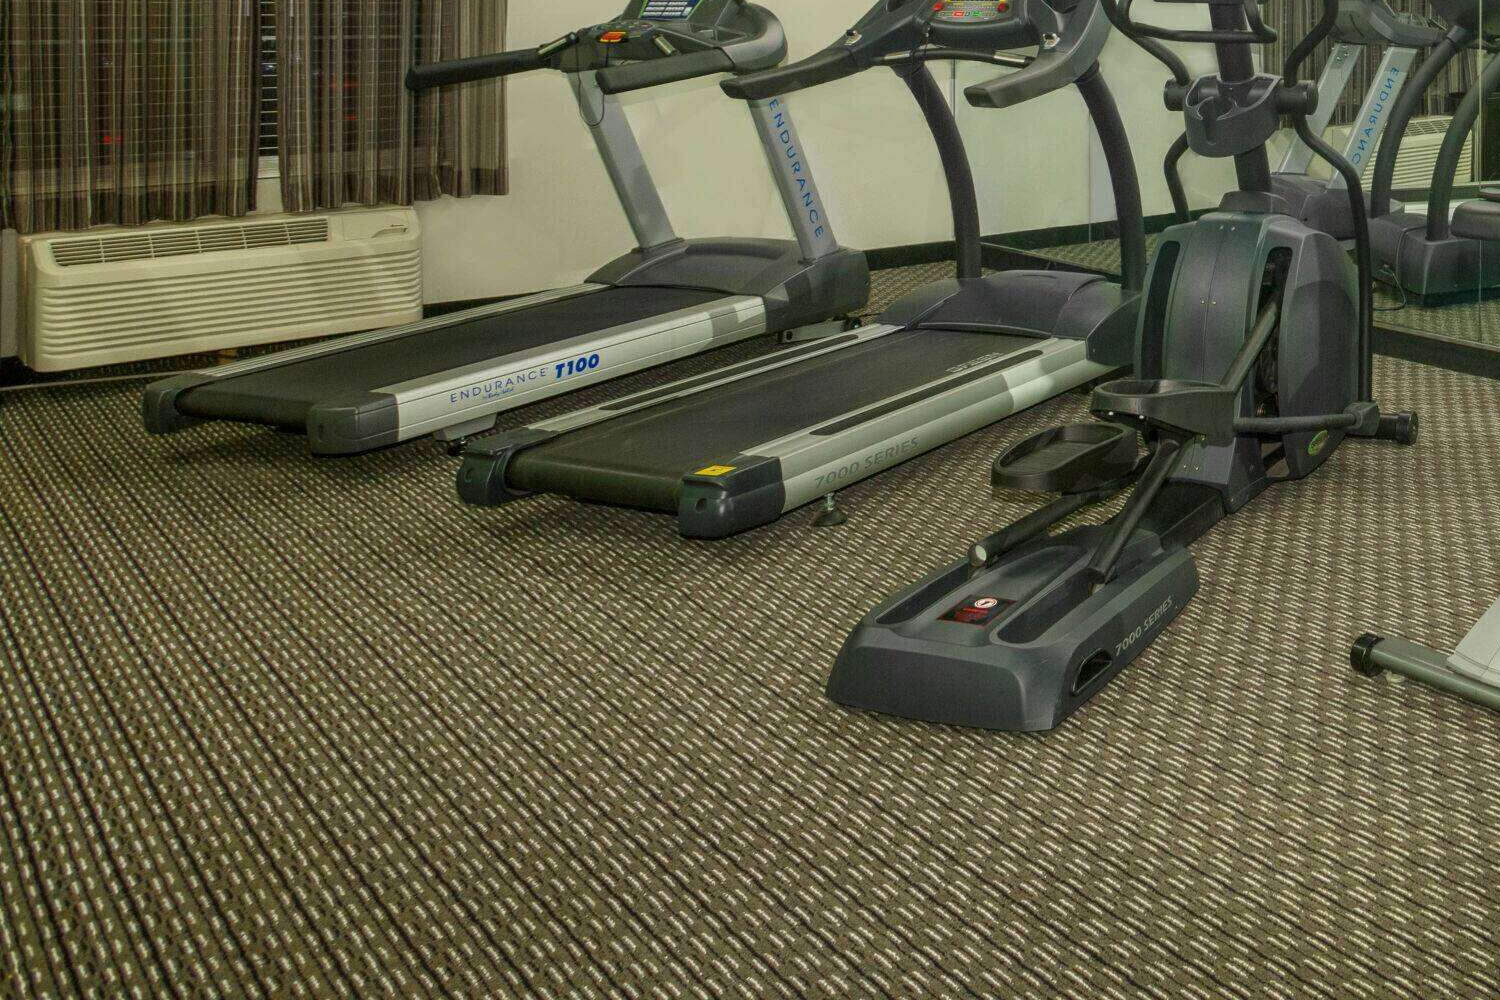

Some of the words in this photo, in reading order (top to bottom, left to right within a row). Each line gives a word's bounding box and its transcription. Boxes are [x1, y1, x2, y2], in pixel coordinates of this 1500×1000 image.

[769, 99, 824, 238] ENDURANCE
[450, 368, 546, 403] ENDURANCE
[555, 354, 599, 379] T100
[814, 462, 860, 489] 7000
[864, 435, 920, 471] SERIES
[1114, 627, 1143, 657] 7000
[1143, 595, 1175, 637] SERIES
